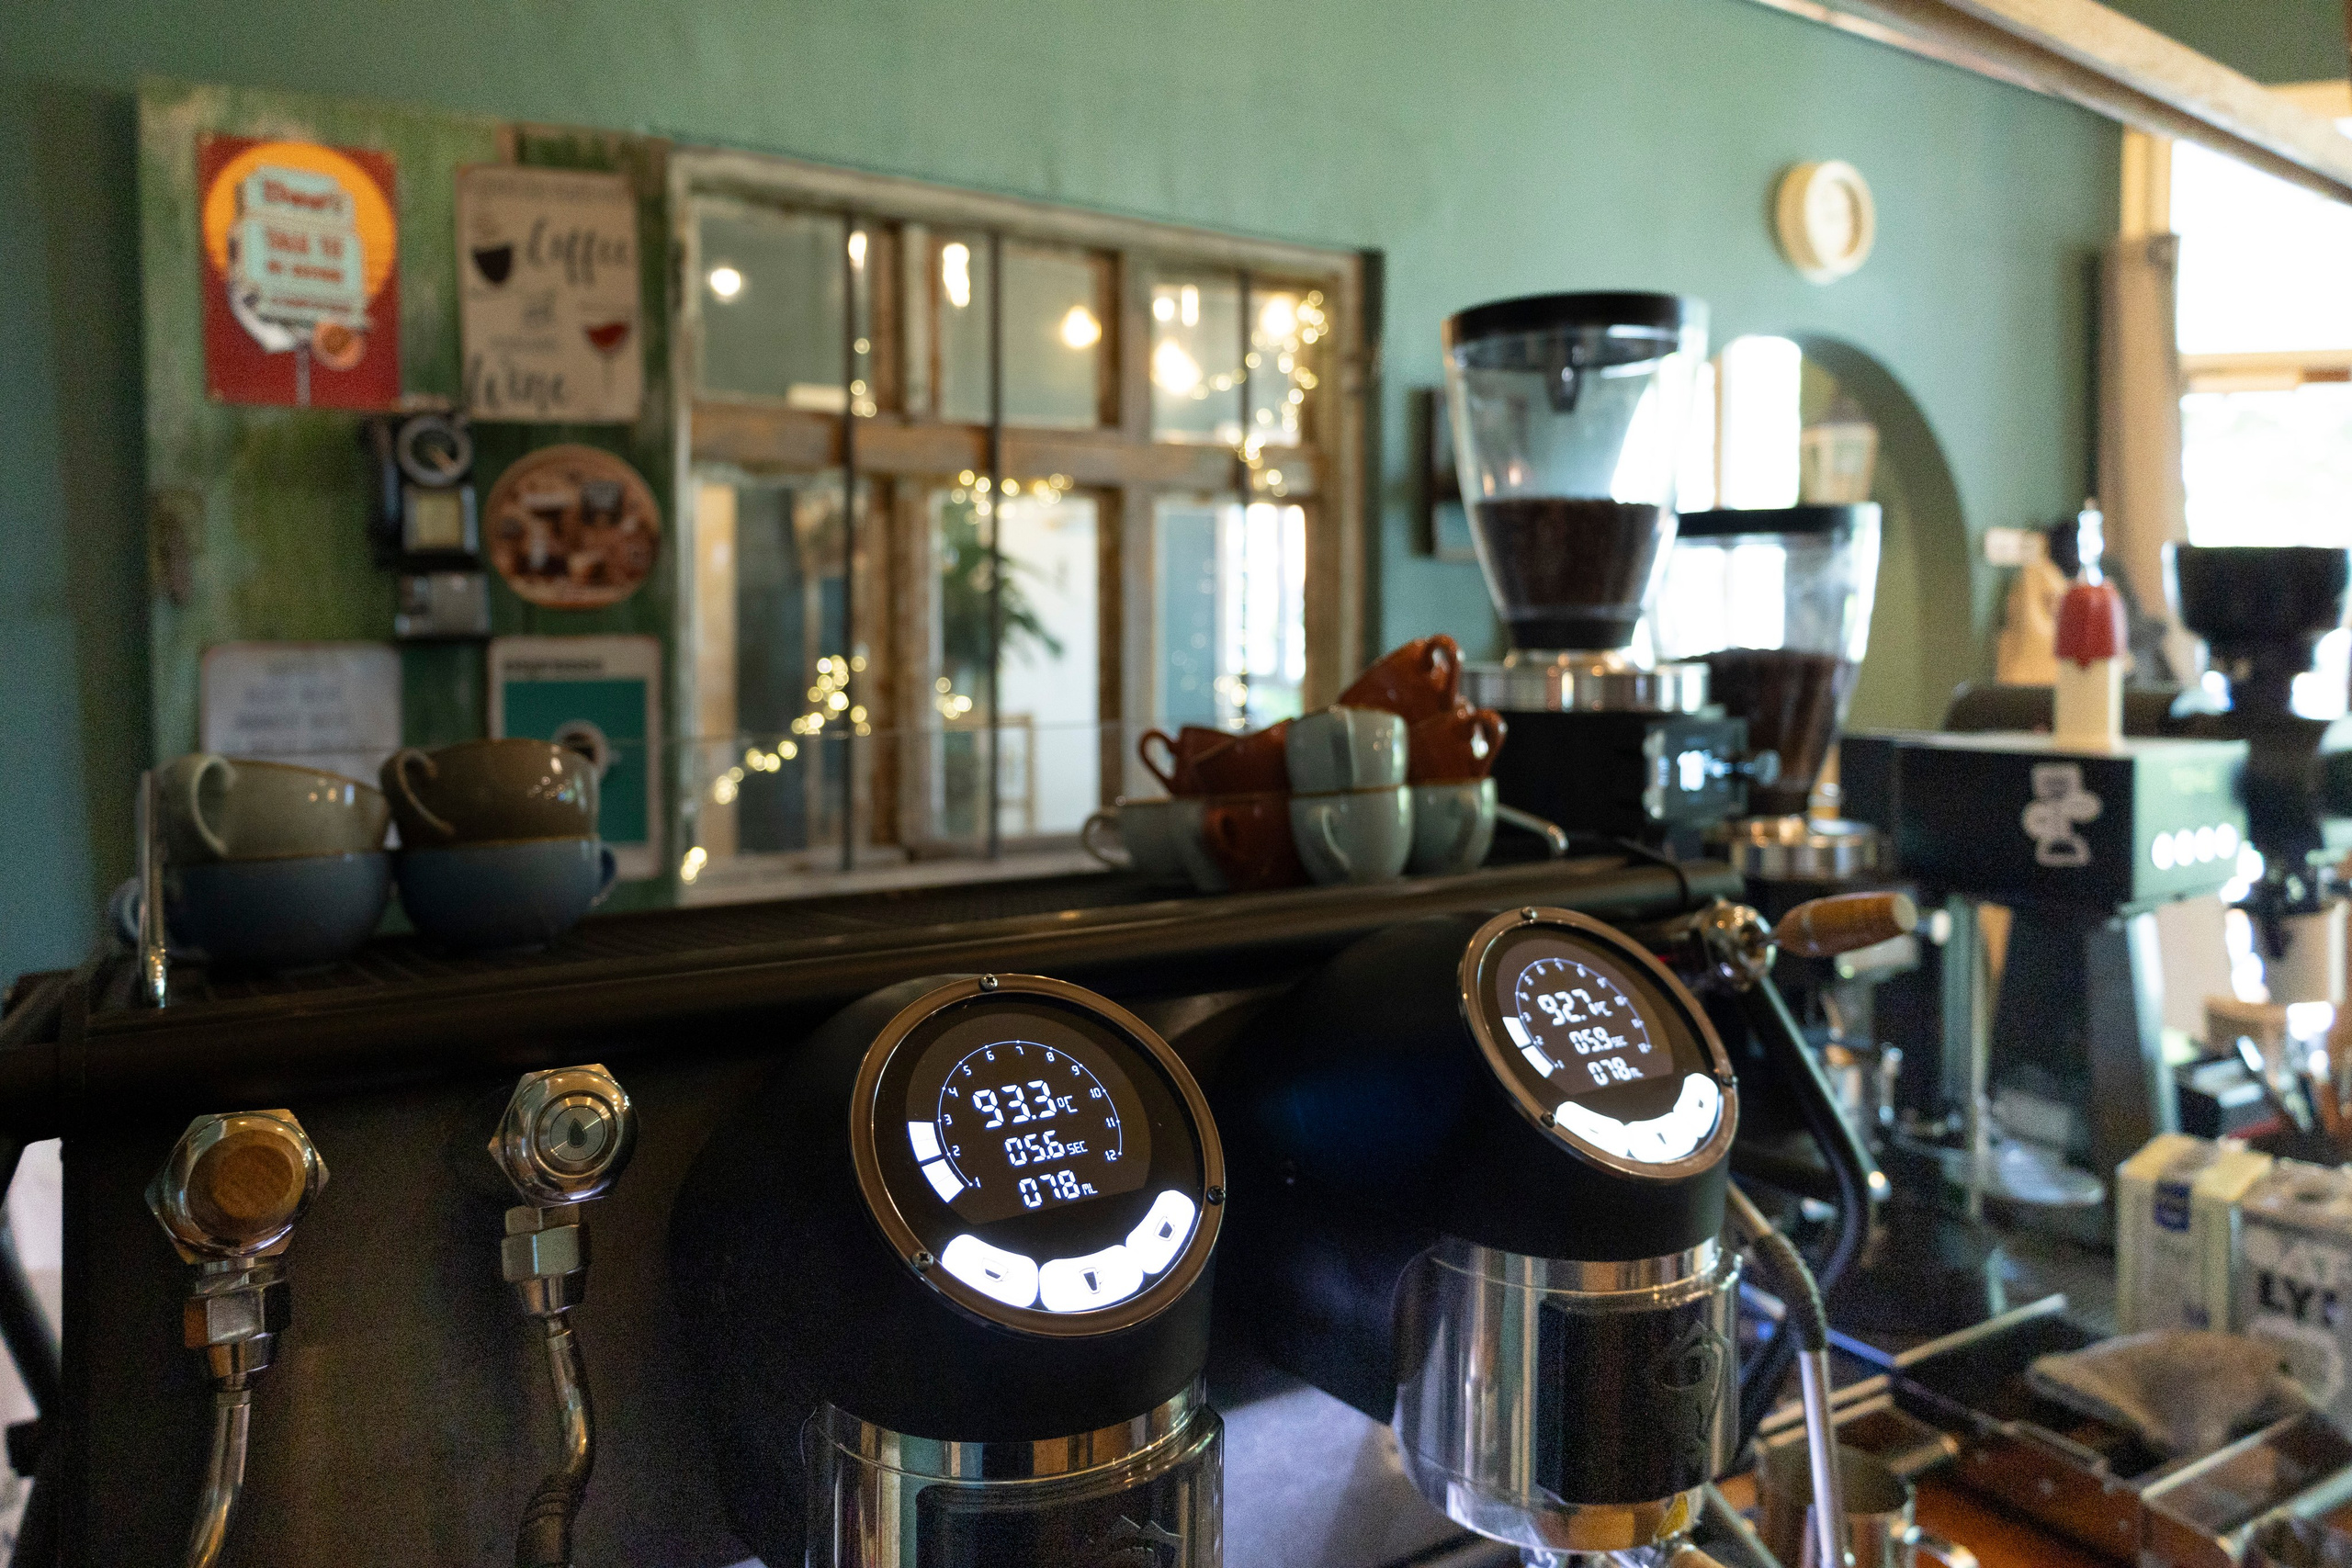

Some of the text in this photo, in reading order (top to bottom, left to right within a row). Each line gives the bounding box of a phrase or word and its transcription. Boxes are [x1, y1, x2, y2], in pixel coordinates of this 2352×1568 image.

[986, 1050, 995, 1061] 6
[1015, 1045, 1024, 1055] 7
[1046, 1051, 1056, 1062] 8
[963, 1065, 972, 1076] 5
[1070, 1065, 1080, 1076] 9
[1587, 1056, 1633, 1087] 078
[948, 1087, 958, 1098] 4
[1090, 1087, 1102, 1099] 10
[944, 1114, 953, 1125] 3
[1105, 1117, 1115, 1128] 11
[952, 1145, 961, 1156] 2
[1004, 1130, 1089, 1167] 05.6 SEC
[1104, 1149, 1117, 1161] 12
[1018, 1169, 1099, 1208] 078 ML
